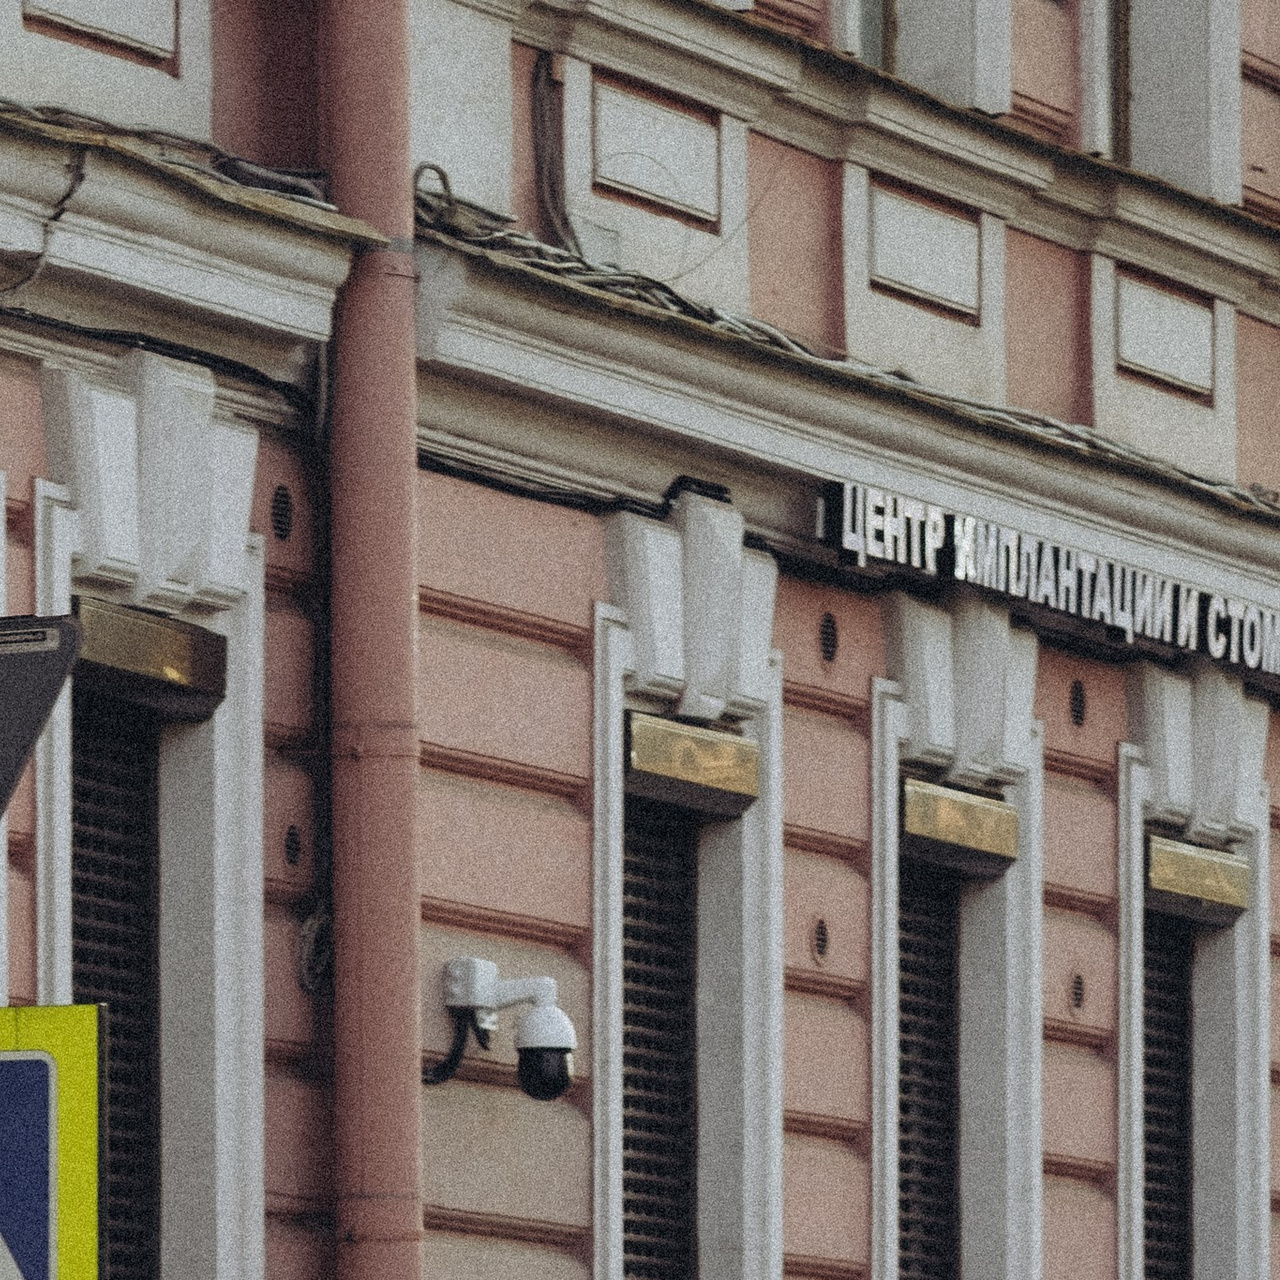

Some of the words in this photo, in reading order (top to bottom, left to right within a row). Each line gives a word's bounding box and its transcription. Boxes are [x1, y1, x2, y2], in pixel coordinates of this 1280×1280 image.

[842, 482, 945, 576] ЦЕНТР
[954, 514, 1174, 645] ИМПЛАНТАЦИИ
[1177, 585, 1200, 651] И
